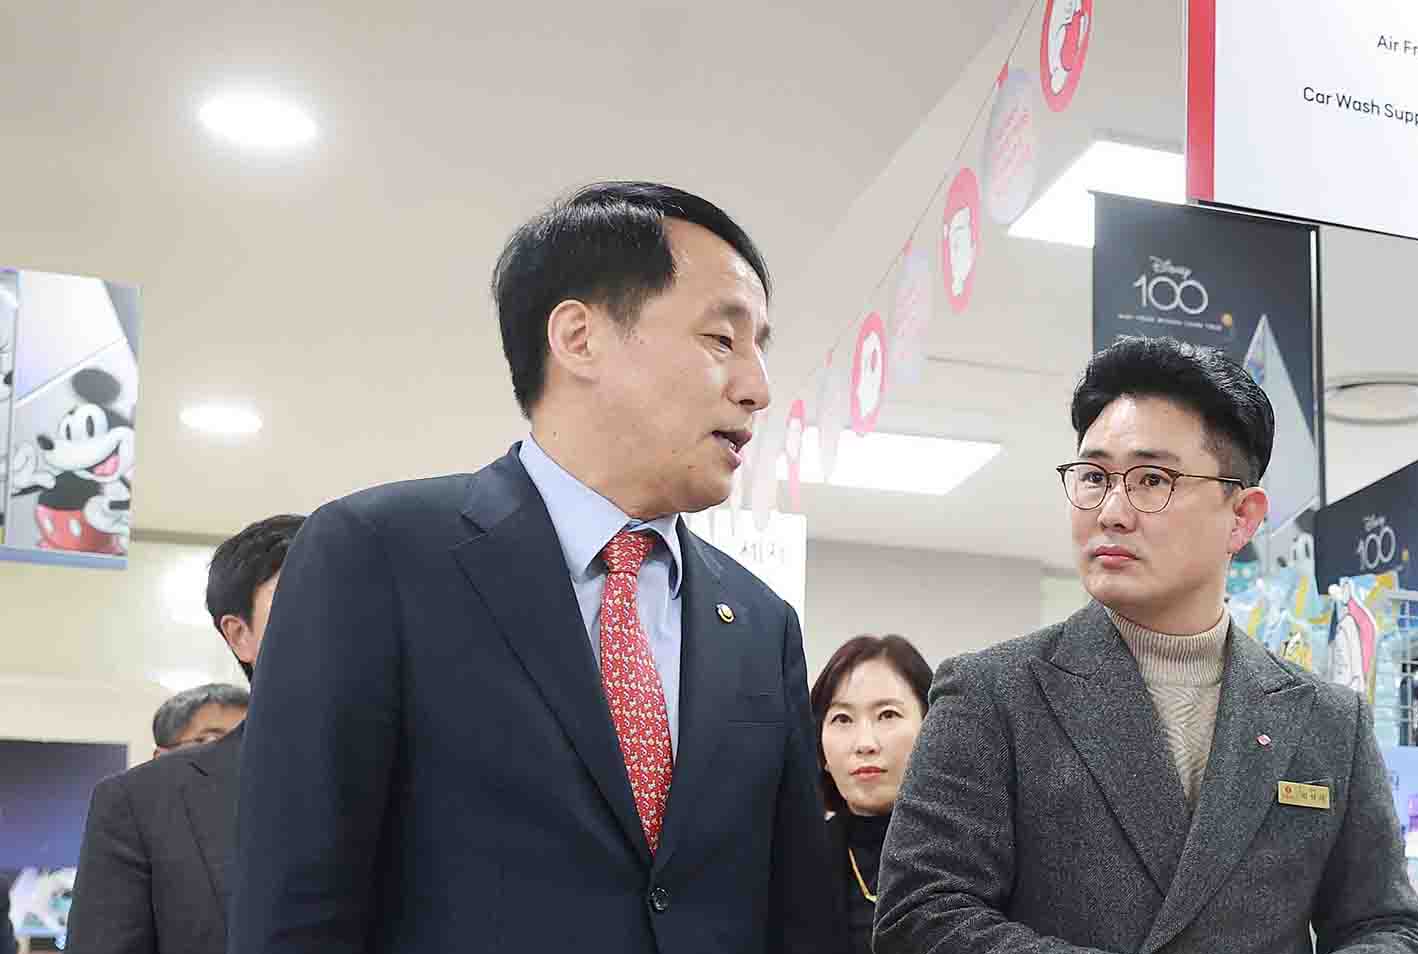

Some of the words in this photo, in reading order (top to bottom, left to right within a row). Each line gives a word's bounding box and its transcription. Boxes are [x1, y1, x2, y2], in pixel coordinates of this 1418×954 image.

[1377, 35, 1399, 51] Air
[1303, 87, 1331, 105] Car
[1336, 94, 1380, 116] Wash
[1133, 274, 1208, 315] 100
[1357, 526, 1396, 569] 100
